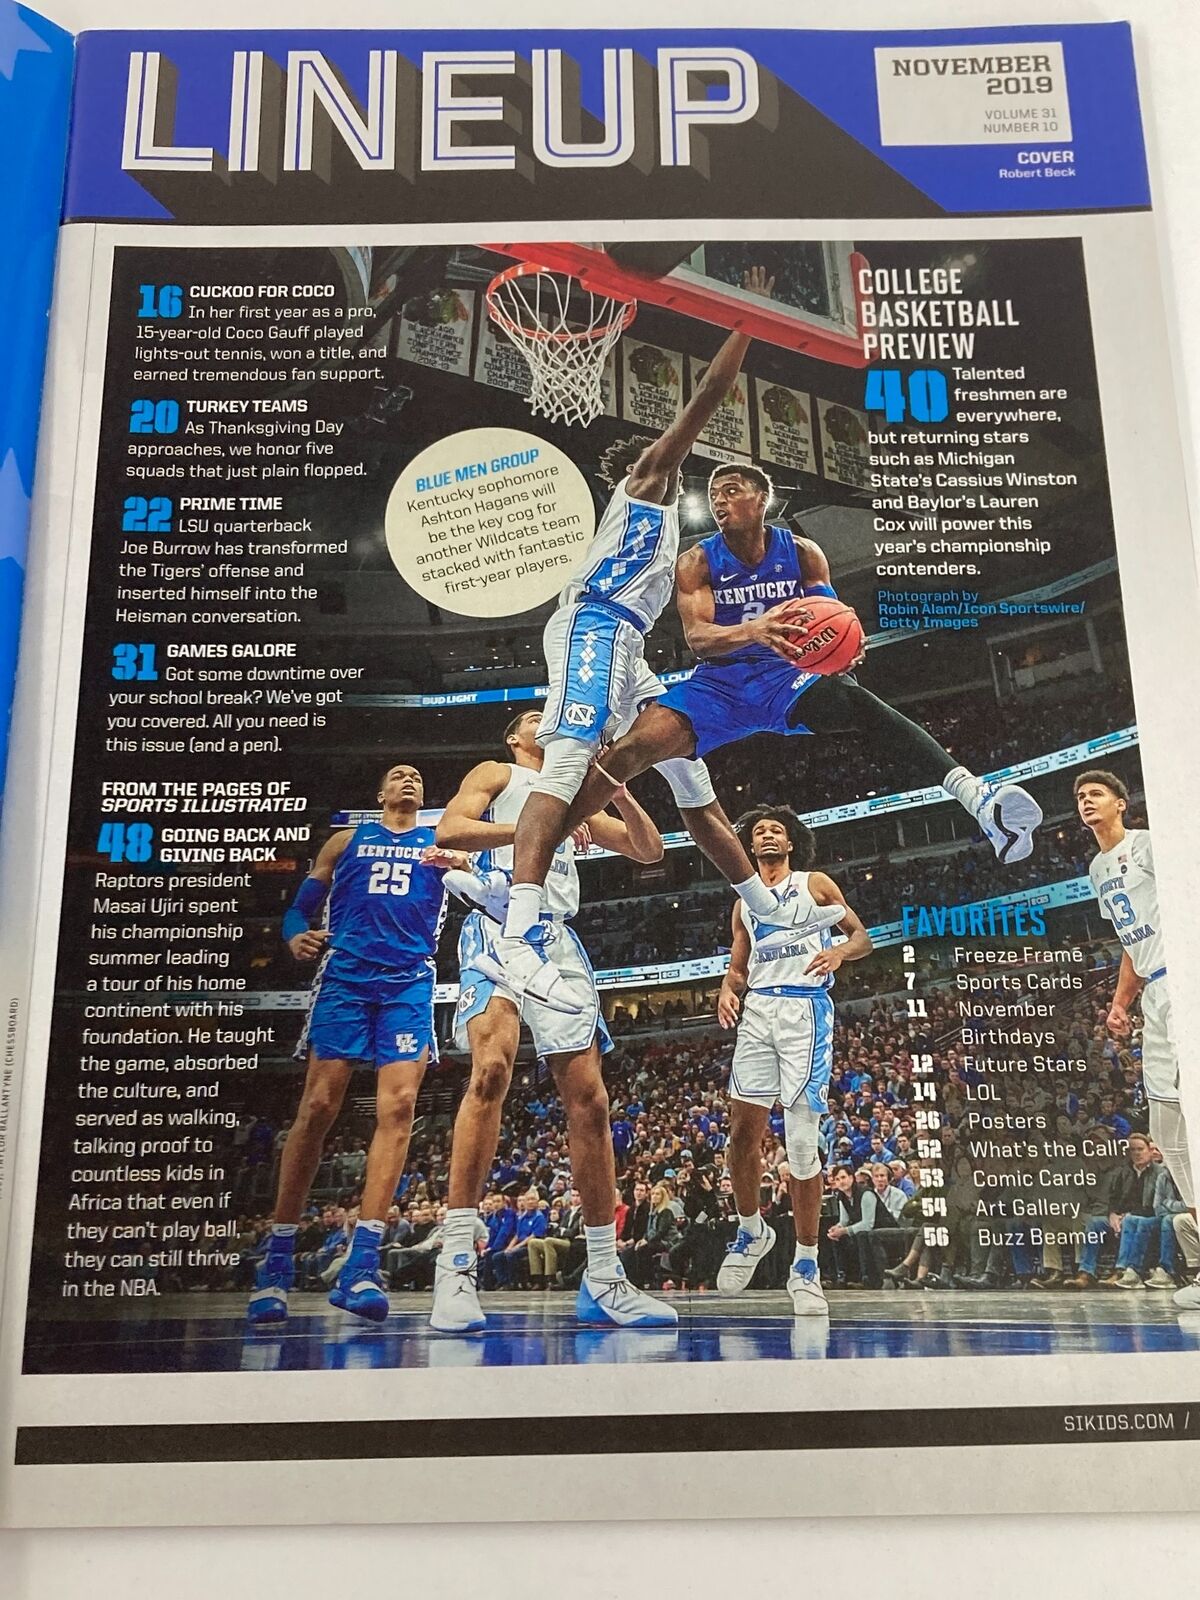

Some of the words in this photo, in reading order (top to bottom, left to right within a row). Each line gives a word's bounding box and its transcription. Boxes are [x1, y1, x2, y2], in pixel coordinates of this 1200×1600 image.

[892, 55, 1051, 76] NOVEMBER
[986, 76, 1053, 96] 2019
[121, 47, 760, 172] LINEUP
[984, 109, 1037, 120] VOLUME
[1041, 108, 1057, 119] 31
[983, 122, 1040, 134] NUMBER
[1043, 122, 1058, 133] 10
[1017, 150, 1075, 164] COVER
[999, 168, 1041, 179] Robert
[1044, 167, 1076, 179] Beck
[859, 268, 963, 295] COLLEGE
[137, 284, 184, 319] 16
[190, 285, 254, 298] CUCKOO
[258, 285, 288, 297] FOR
[292, 285, 335, 298] COCO
[189, 306, 205, 319] In
[209, 305, 234, 319] her
[239, 305, 270, 319] first
[275, 307, 308, 321] year
[312, 308, 330, 318] as
[334, 308, 344, 318] a
[348, 308, 377, 320] pro,
[861, 300, 1020, 327] BASKETBALL
[136, 326, 221, 341] 15-year-old
[226, 327, 264, 339] Coco
[268, 326, 310, 339] Gauff
[314, 325, 364, 341] played
[863, 332, 975, 360] PREVIEW
[864, 369, 949, 423] 40
[952, 366, 1026, 380] Talented
[954, 388, 1037, 401] freshmen
[1040, 389, 1068, 400] are
[128, 399, 181, 435] 20
[187, 400, 250, 413] TURKEY
[253, 400, 308, 413] TEAMS
[956, 408, 1062, 425] everywhere,
[416, 471, 452, 493] BLUE
[455, 463, 488, 483] MEN
[491, 448, 540, 473] GROUP
[406, 487, 475, 513] Kentucky
[477, 465, 560, 495] sophomore
[122, 495, 173, 533] 22
[180, 498, 236, 511] PRIME
[239, 497, 283, 510] TIME
[421, 506, 472, 528] Ashton
[474, 491, 530, 514] Hagans
[531, 481, 557, 498] will
[428, 530, 448, 544] be
[449, 523, 476, 538] the
[478, 515, 504, 532] key
[507, 507, 534, 524] cog
[537, 501, 558, 515] for
[416, 541, 473, 565] another
[475, 524, 540, 550] Wildcats
[541, 513, 581, 532] team
[421, 556, 481, 582] stacked
[483, 547, 516, 566] with
[518, 530, 585, 557] fantastic
[444, 568, 512, 595] first-year
[515, 554, 573, 578] players.
[713, 580, 798, 605] KENTUCKY
[877, 591, 959, 606] Photograph
[962, 590, 979, 604] by
[878, 603, 919, 615] Robin
[922, 602, 997, 615] Alam/Icon
[999, 601, 1086, 617] Sportswire/
[879, 616, 920, 631] Getty
[923, 616, 979, 630] Images
[111, 643, 159, 681] 31
[166, 644, 228, 658] GAMES
[231, 643, 297, 657] GALORE
[422, 696, 446, 705] BUD
[446, 693, 478, 704] LIGHT
[101, 782, 158, 797] FROM
[161, 782, 198, 796] THE
[202, 782, 265, 796] PAGES
[267, 781, 291, 795] OF
[101, 798, 179, 813] SPORTS
[180, 797, 307, 813] ILLUSTRATED
[97, 821, 154, 863] 48
[161, 828, 219, 843] GOING
[223, 827, 271, 843] BACK
[274, 827, 311, 842] AND
[356, 844, 426, 860] KENTUCK
[160, 848, 225, 863] GIVING
[229, 847, 277, 862] BACK
[95, 873, 164, 891] Raptors
[168, 872, 252, 891] president
[368, 861, 413, 896] 25
[93, 898, 146, 914] Masai
[151, 898, 184, 917] Ujiri
[188, 898, 239, 916] spent
[1103, 892, 1136, 931] 13
[902, 905, 1047, 938] FAVORITES
[902, 945, 916, 964] 2
[954, 947, 1018, 964] Freeze
[904, 972, 916, 990] 7
[956, 974, 1022, 993] Sports
[1027, 973, 1083, 990] Cards
[907, 999, 928, 1018] 11
[958, 1000, 1056, 1018] November
[962, 1028, 1056, 1048] Birthdays
[911, 1054, 934, 1073] 12
[963, 1056, 1028, 1073] Future
[1033, 1055, 1087, 1072] Stars
[913, 1082, 937, 1101] 14
[966, 1084, 1002, 1101] LOL
[914, 1110, 941, 1130] 26
[969, 1112, 1047, 1130] Posters
[917, 1139, 943, 1159] 52
[970, 1140, 1039, 1158] What's
[1043, 1139, 1077, 1158] the
[1082, 1138, 1130, 1157] Call?
[919, 1168, 945, 1188] 53
[973, 1169, 1035, 1188] Comic
[1039, 1168, 1097, 1187] Cards
[921, 1197, 948, 1218] 54
[976, 1199, 1007, 1217] Art
[1012, 1198, 1081, 1219] Gallery
[924, 1227, 950, 1247] 56
[978, 1229, 1025, 1247] Buzz
[1030, 1227, 1107, 1247] Beamer
[64, 1252, 107, 1272] they
[110, 1254, 144, 1268] can
[148, 1250, 183, 1268] still
[187, 1249, 240, 1267] thrive
[62, 1281, 79, 1297] in
[83, 1280, 116, 1297] the
[120, 1279, 161, 1297] NBA.
[1064, 1412, 1175, 1432] SIKIDS.COM
[1184, 1411, 1190, 1430] /
